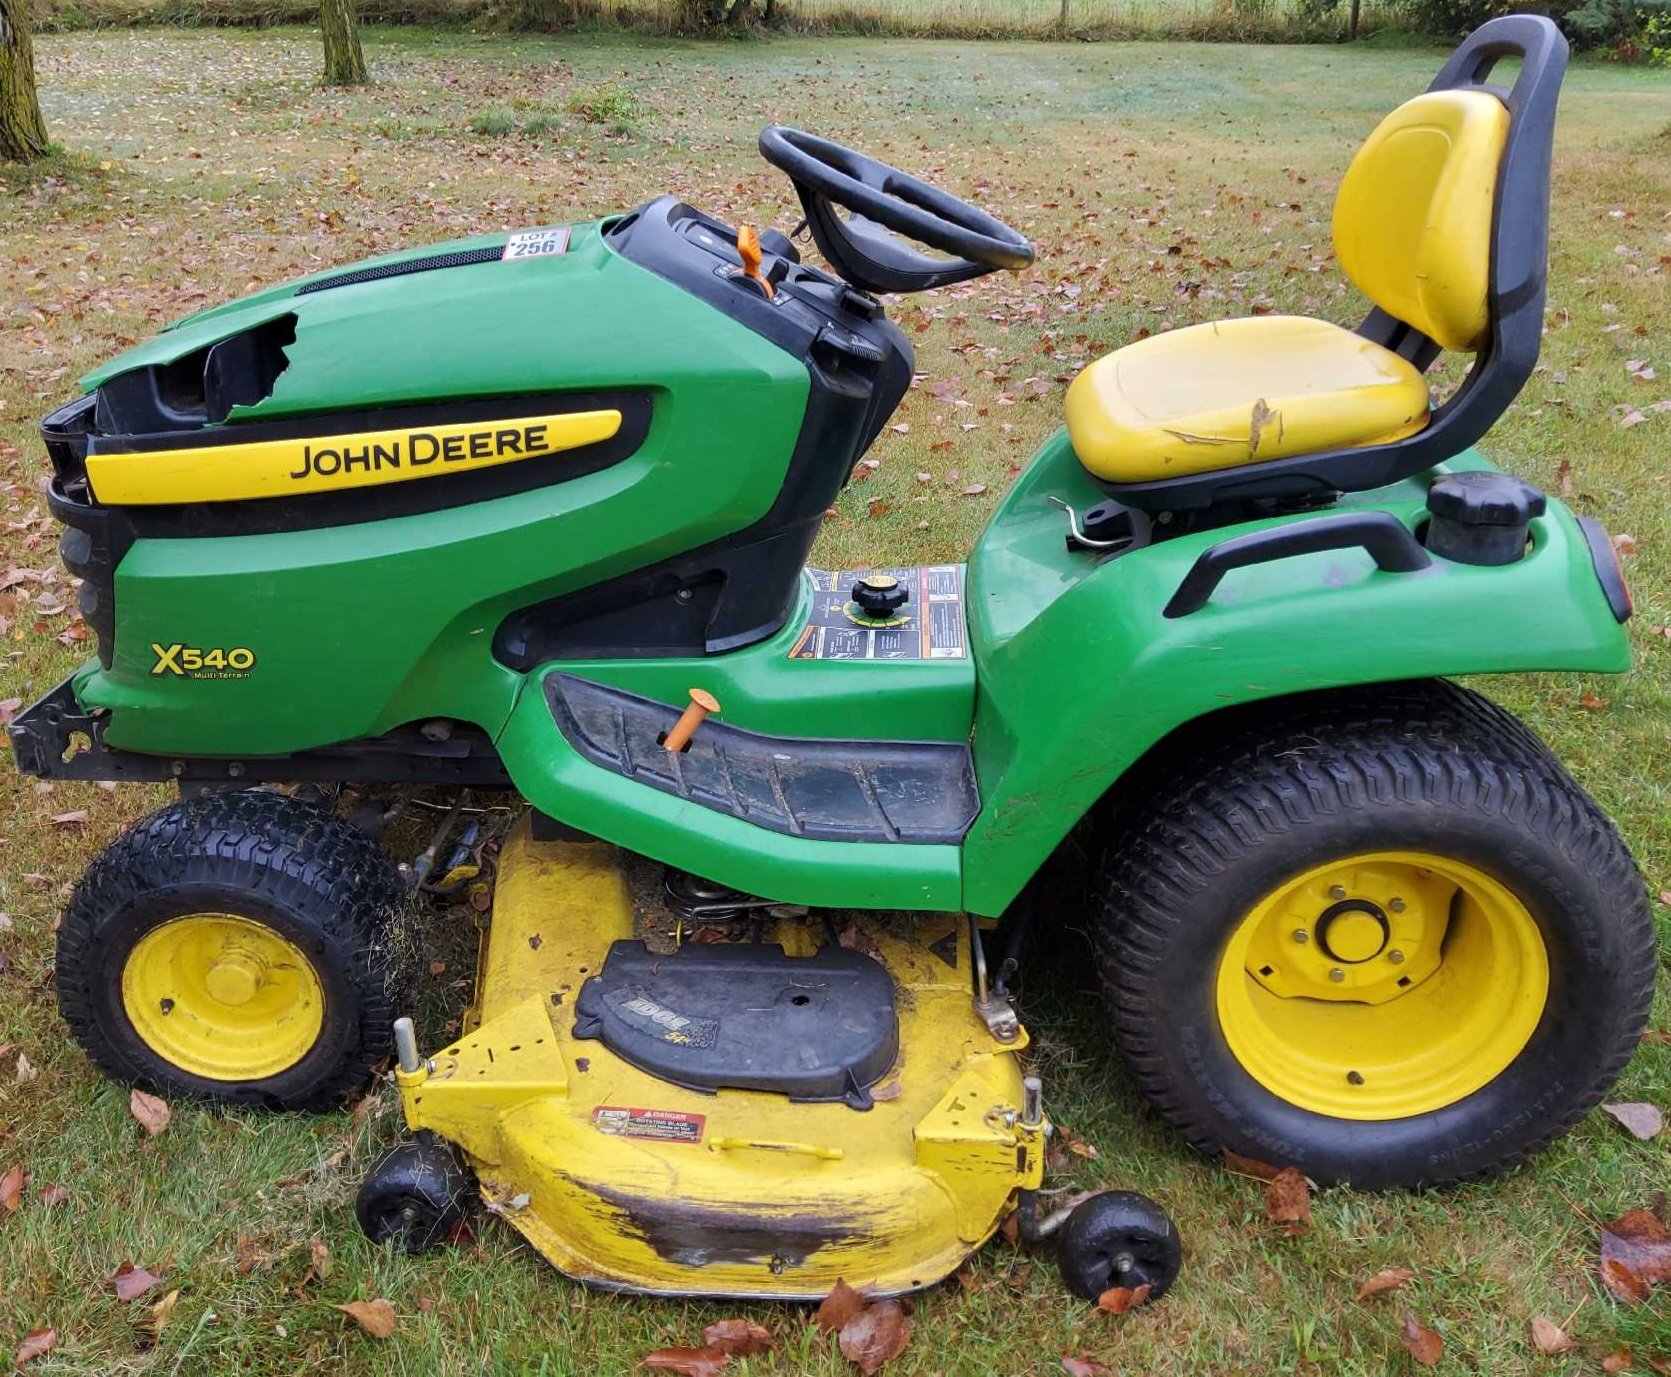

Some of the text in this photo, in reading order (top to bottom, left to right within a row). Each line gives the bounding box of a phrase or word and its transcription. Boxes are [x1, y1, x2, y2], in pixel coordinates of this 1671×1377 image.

[520, 232, 546, 242] LOT
[514, 240, 555, 256] 256
[290, 424, 550, 479] JOHN DEERE
[151, 642, 255, 675] X540
[653, 1111, 687, 1120] DANGER
